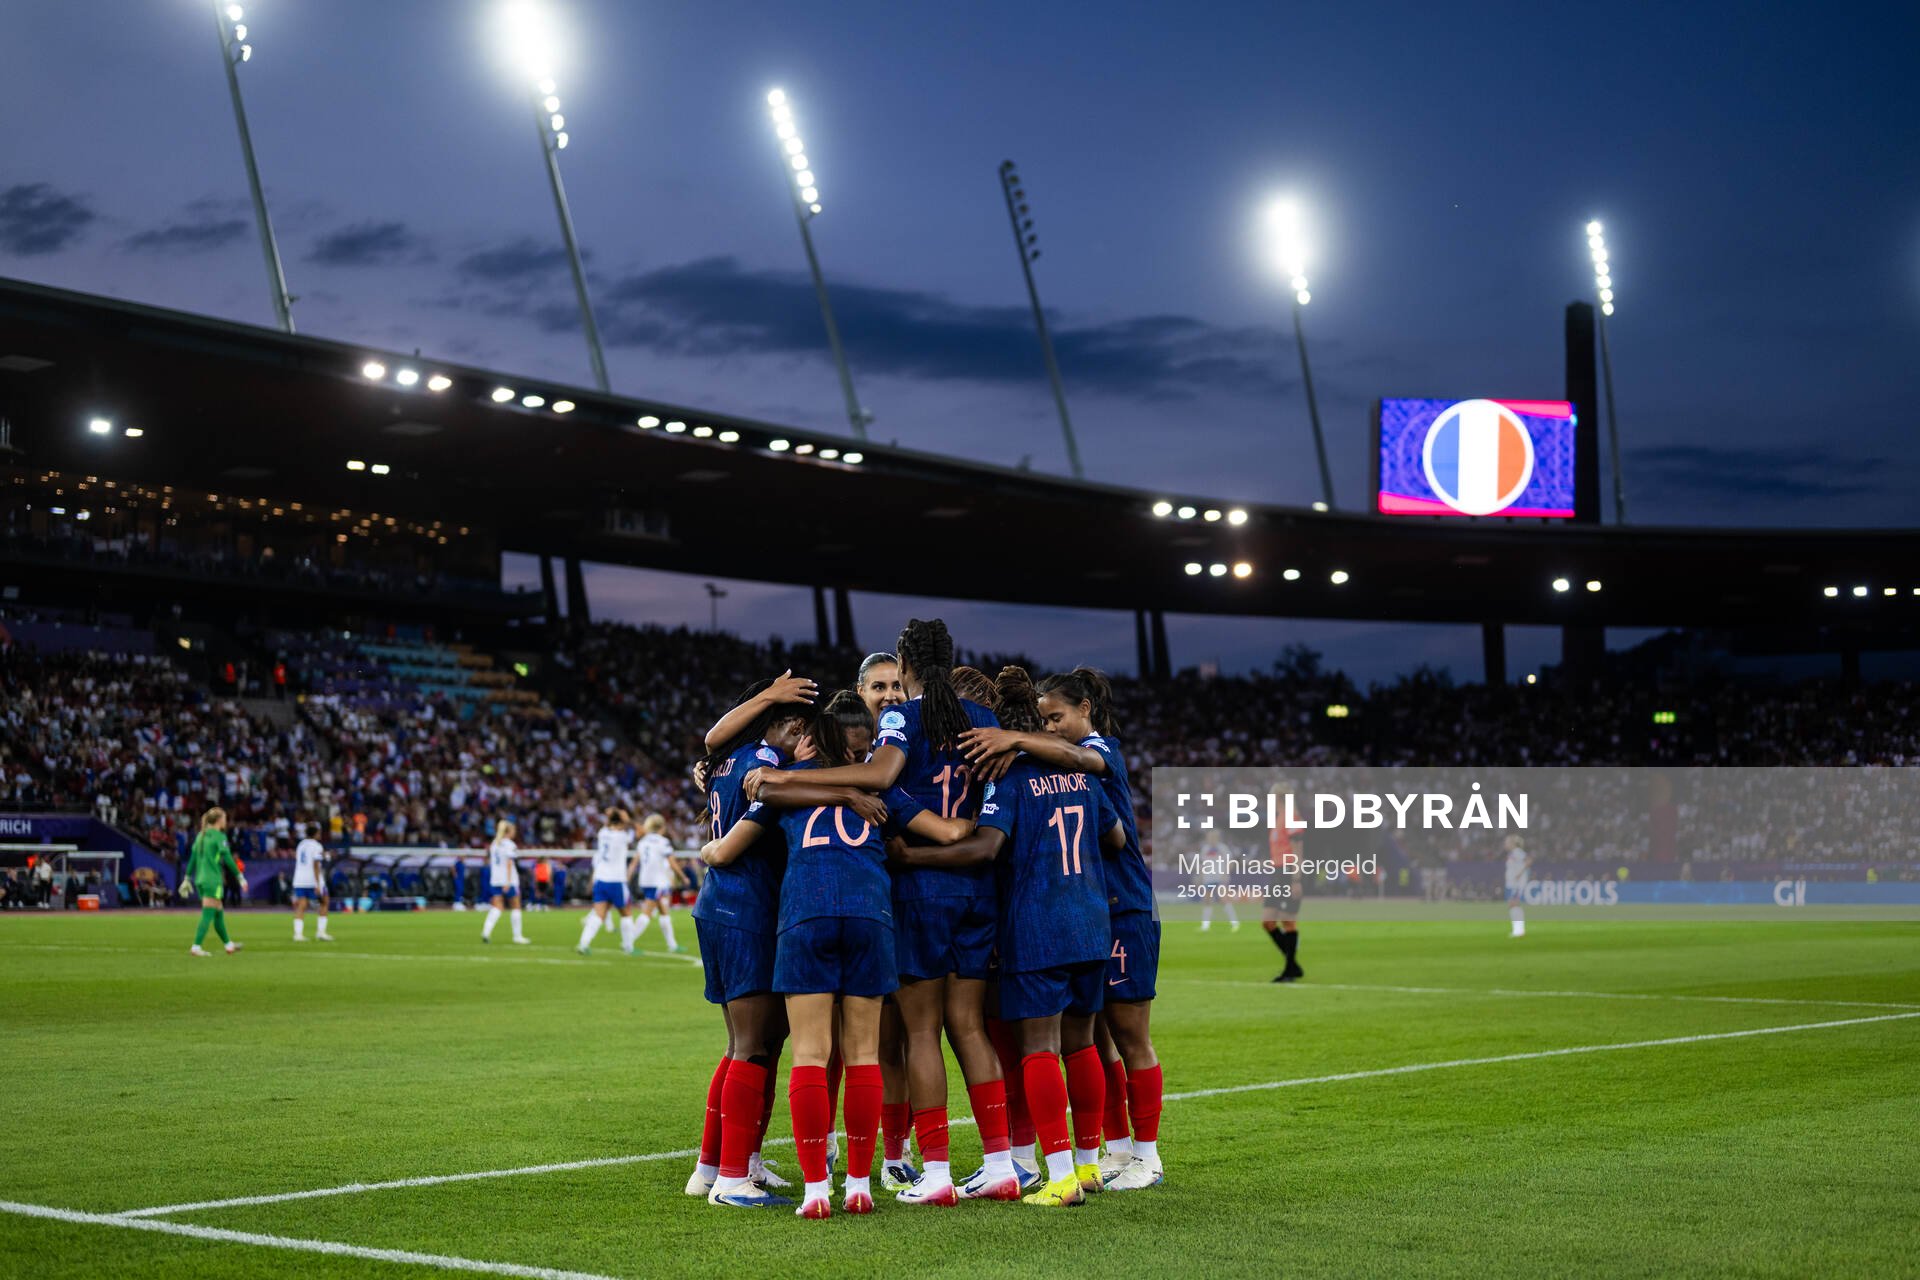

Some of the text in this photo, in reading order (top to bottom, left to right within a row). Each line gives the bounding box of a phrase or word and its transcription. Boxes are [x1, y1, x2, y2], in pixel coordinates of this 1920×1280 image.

[933, 764, 970, 819] 12
[0, 819, 32, 834] RICH
[802, 806, 871, 848] 20
[1048, 805, 1084, 876] 17
[1524, 880, 1619, 906] GRIFOLS
[1110, 939, 1127, 974] 4
